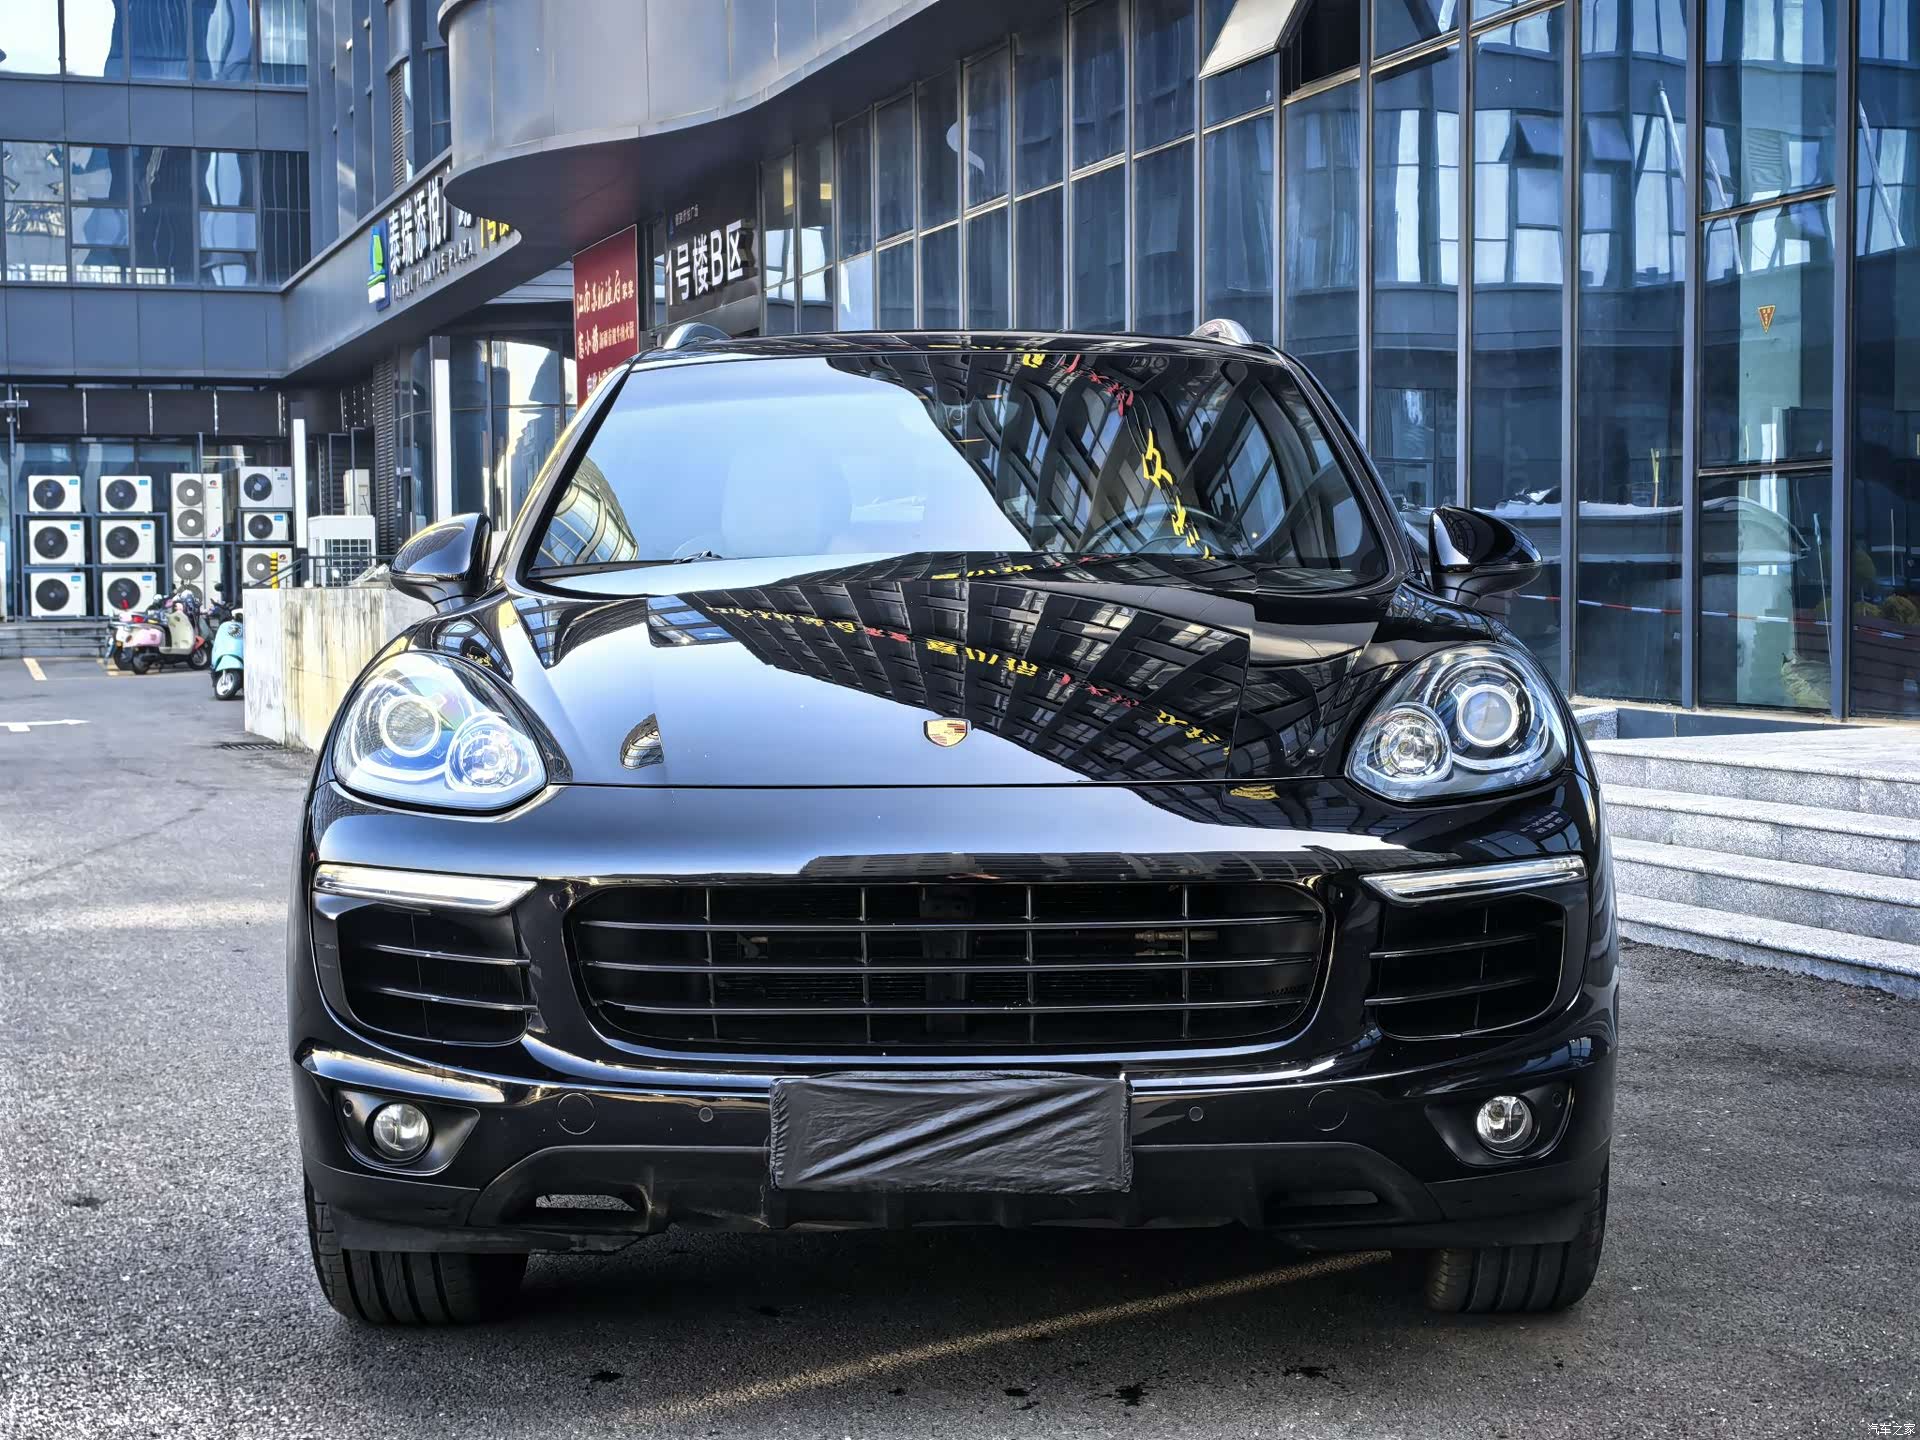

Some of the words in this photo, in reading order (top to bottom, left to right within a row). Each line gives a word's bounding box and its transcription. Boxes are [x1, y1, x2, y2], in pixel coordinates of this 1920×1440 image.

[389, 165, 472, 275] 泰瑞添悦广
[448, 236, 474, 266] PLAZA
[665, 219, 743, 305] 1号楼B区
